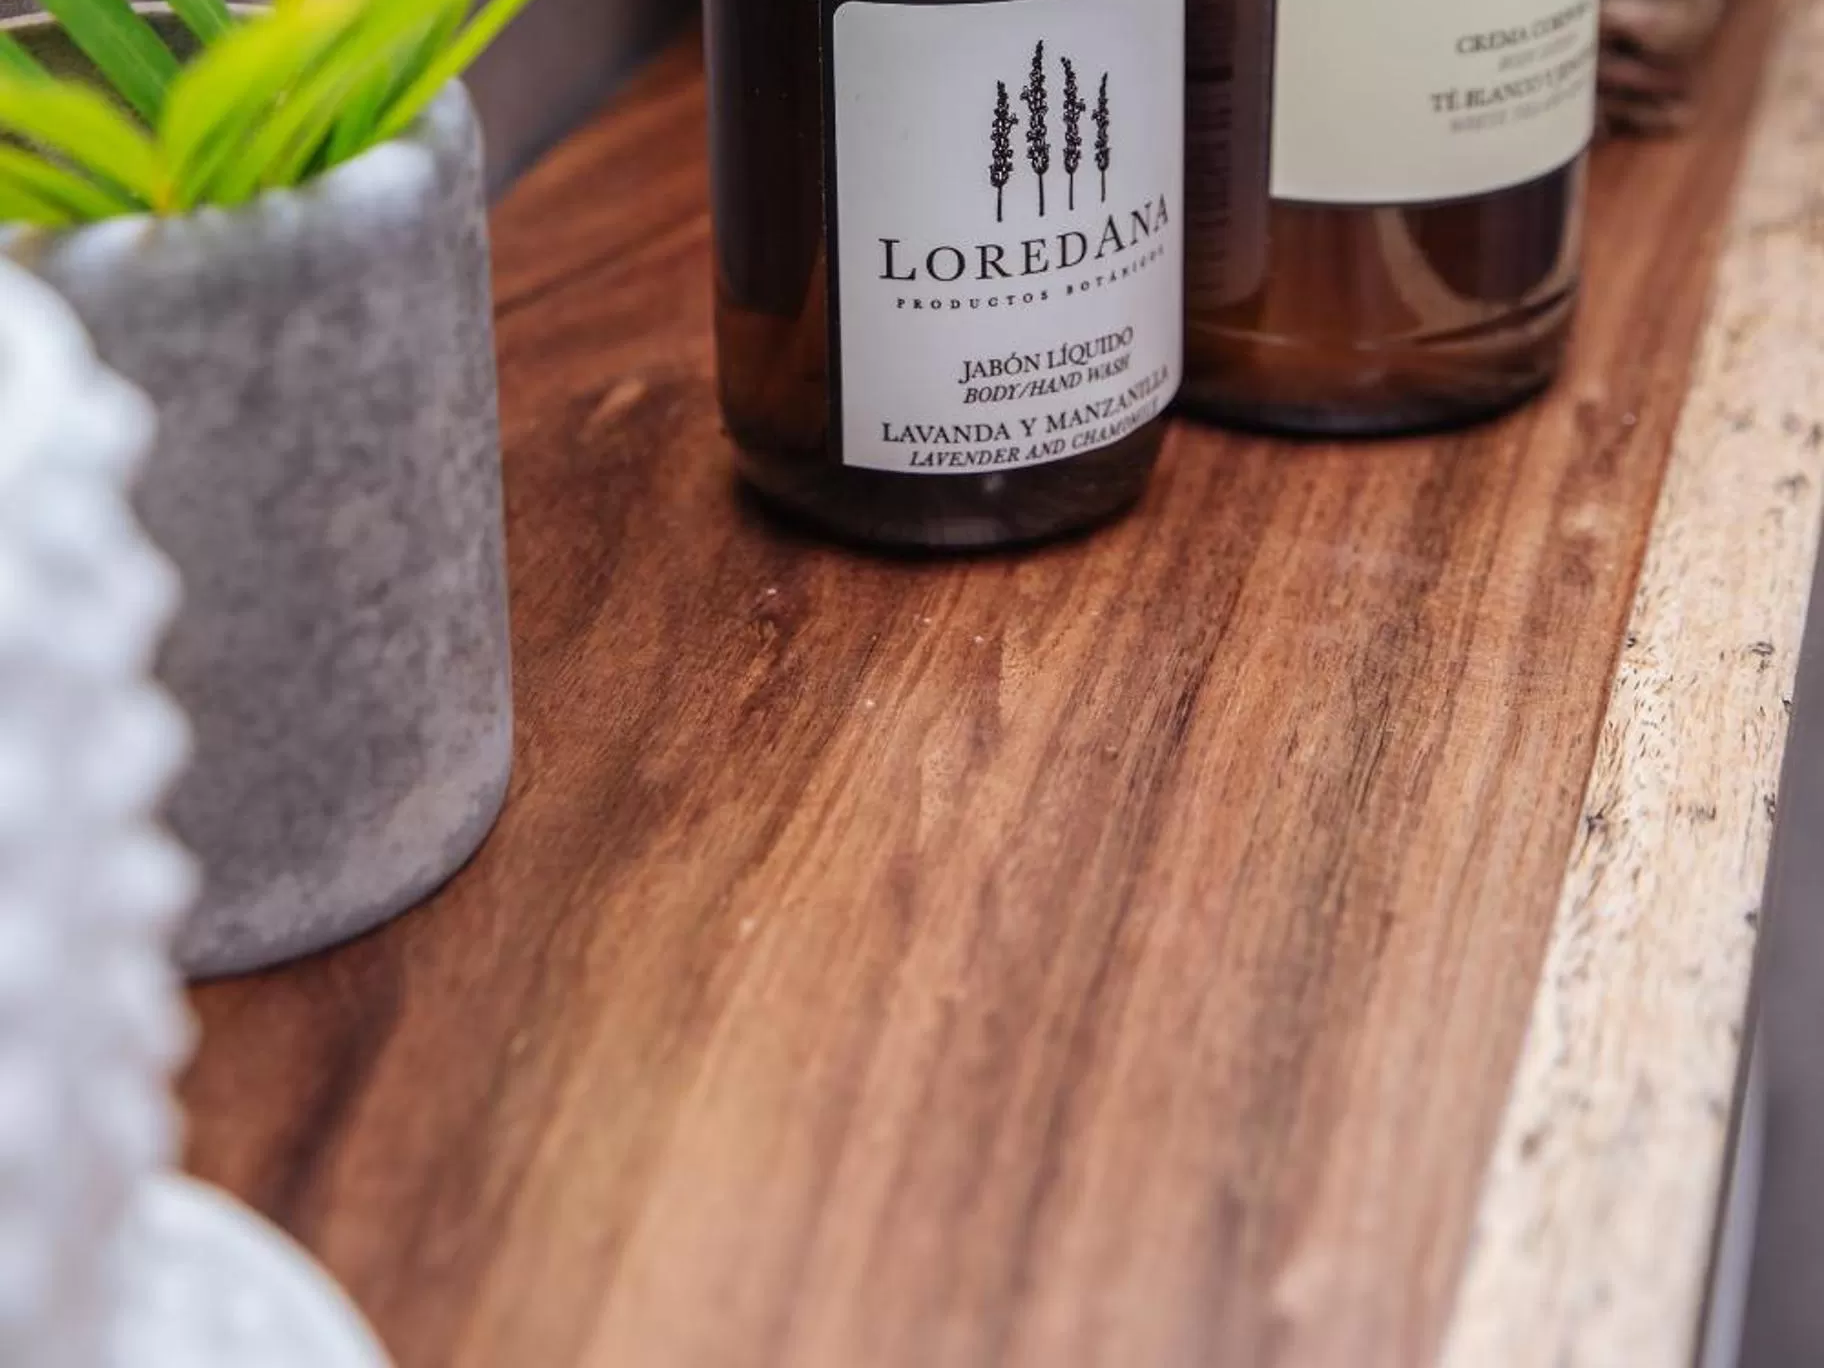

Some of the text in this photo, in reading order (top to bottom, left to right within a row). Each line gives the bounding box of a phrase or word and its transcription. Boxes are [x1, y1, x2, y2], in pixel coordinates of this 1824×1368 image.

[878, 193, 1169, 281] LOREDANA
[896, 290, 1049, 309] PRODUCTOS
[958, 326, 1134, 383] JABÓN LÍQUIDO
[963, 371, 1082, 404] BODY/HAND
[882, 422, 1012, 443] LAVANDA
[1019, 418, 1037, 438] Y
[909, 447, 1020, 467] LAVENDER
[1025, 439, 1066, 460] AND
